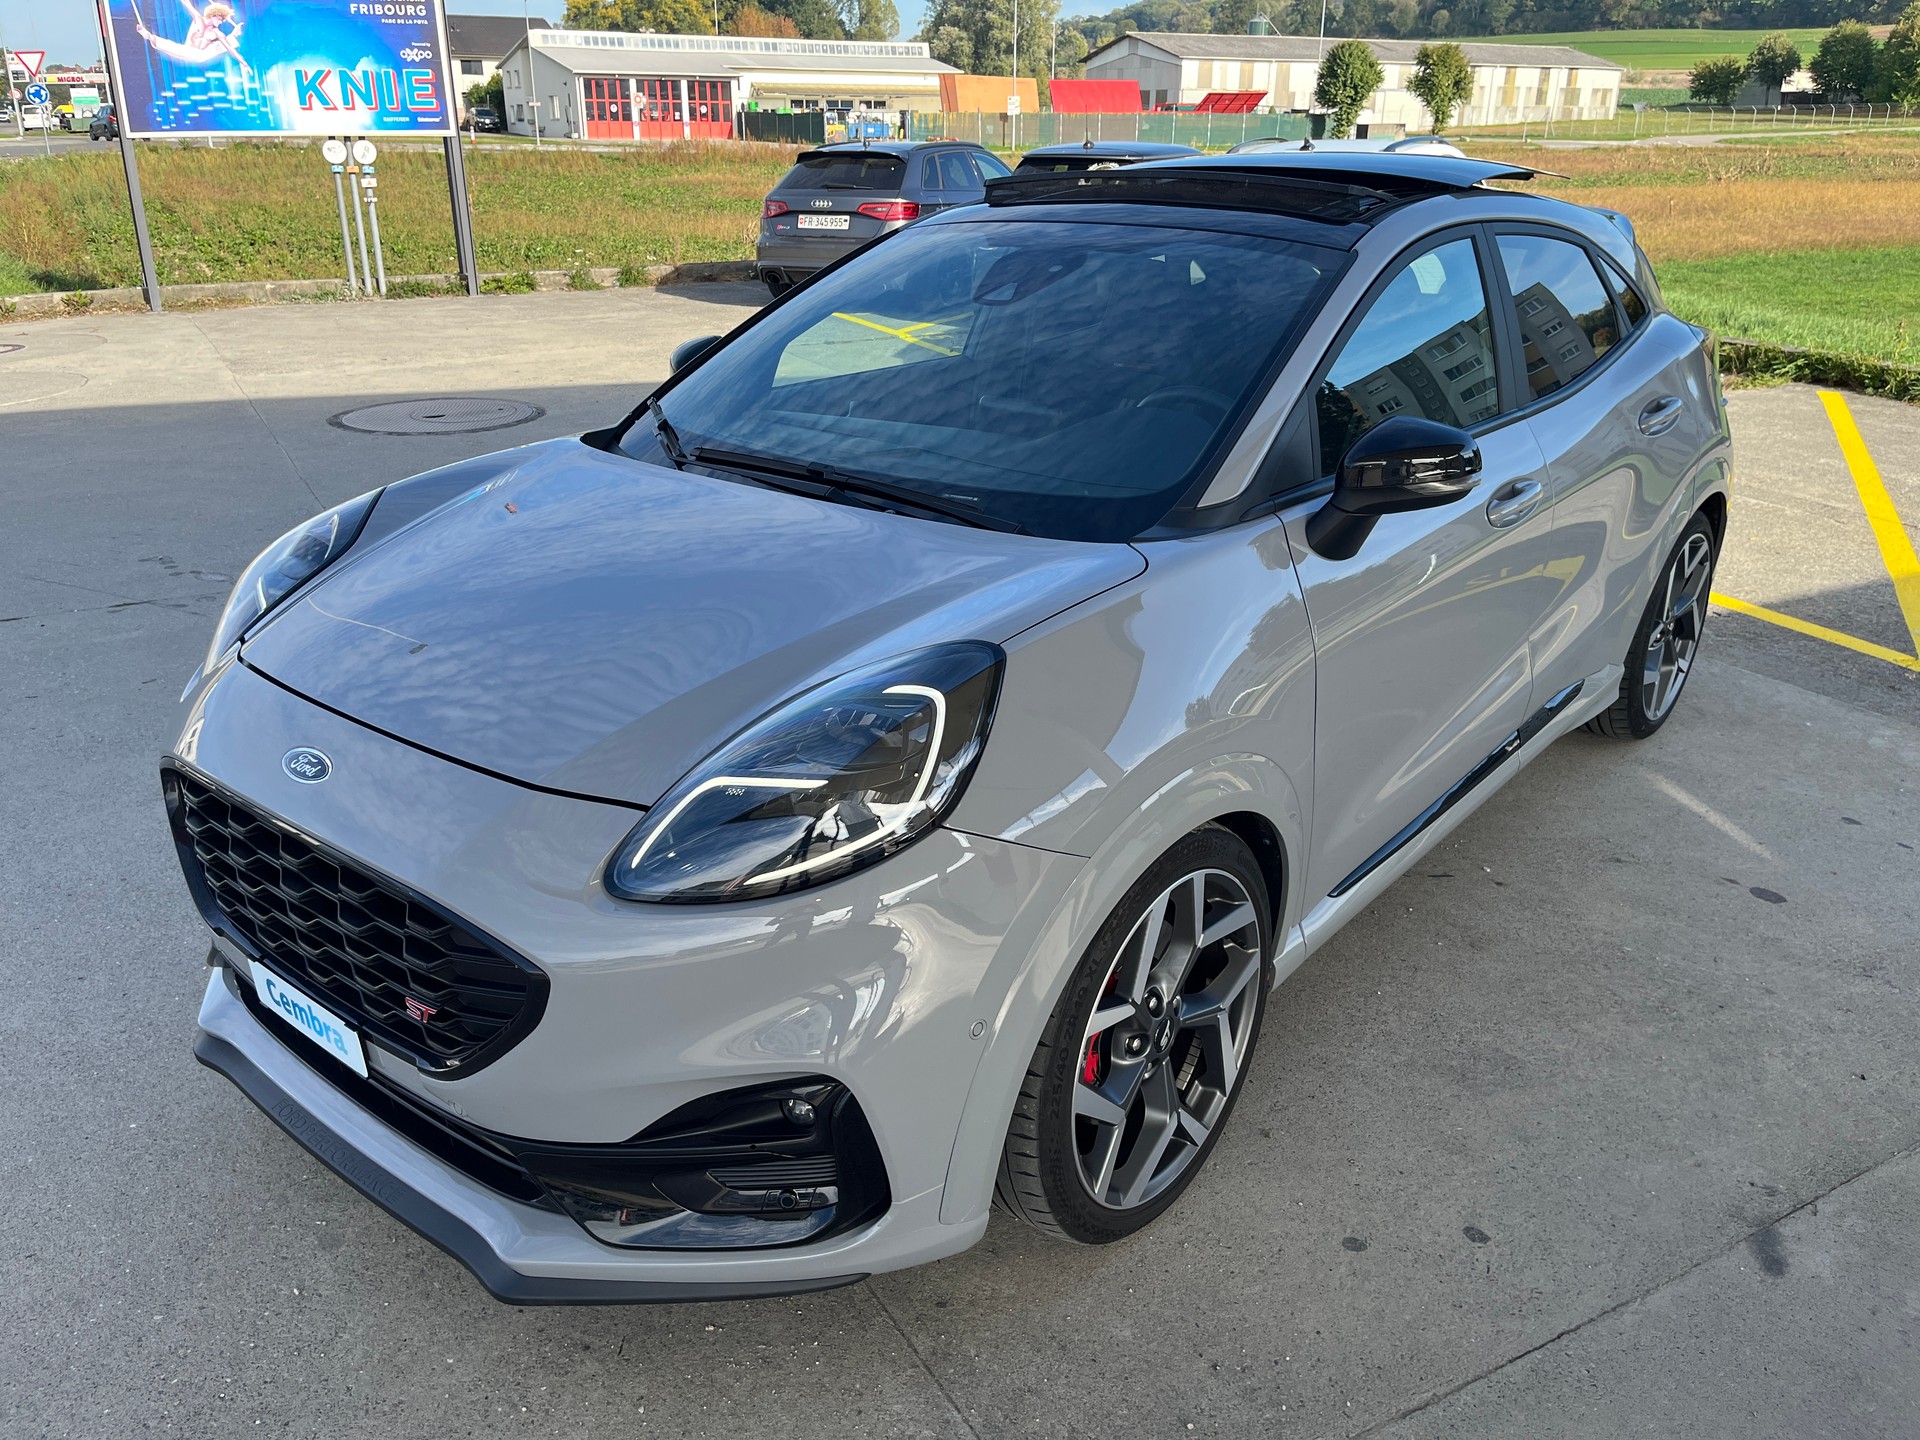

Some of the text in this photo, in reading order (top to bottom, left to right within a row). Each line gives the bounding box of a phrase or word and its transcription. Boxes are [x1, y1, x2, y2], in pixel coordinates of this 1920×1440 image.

[349, 3, 427, 17] FRIBOURG
[57, 75, 85, 83] MIGROL
[294, 68, 440, 112] KNIE
[290, 753, 321, 777] Ford
[266, 978, 349, 1056] Cembra
[405, 996, 438, 1023] ST
[271, 1098, 406, 1205] FORD PERFORMANCE
